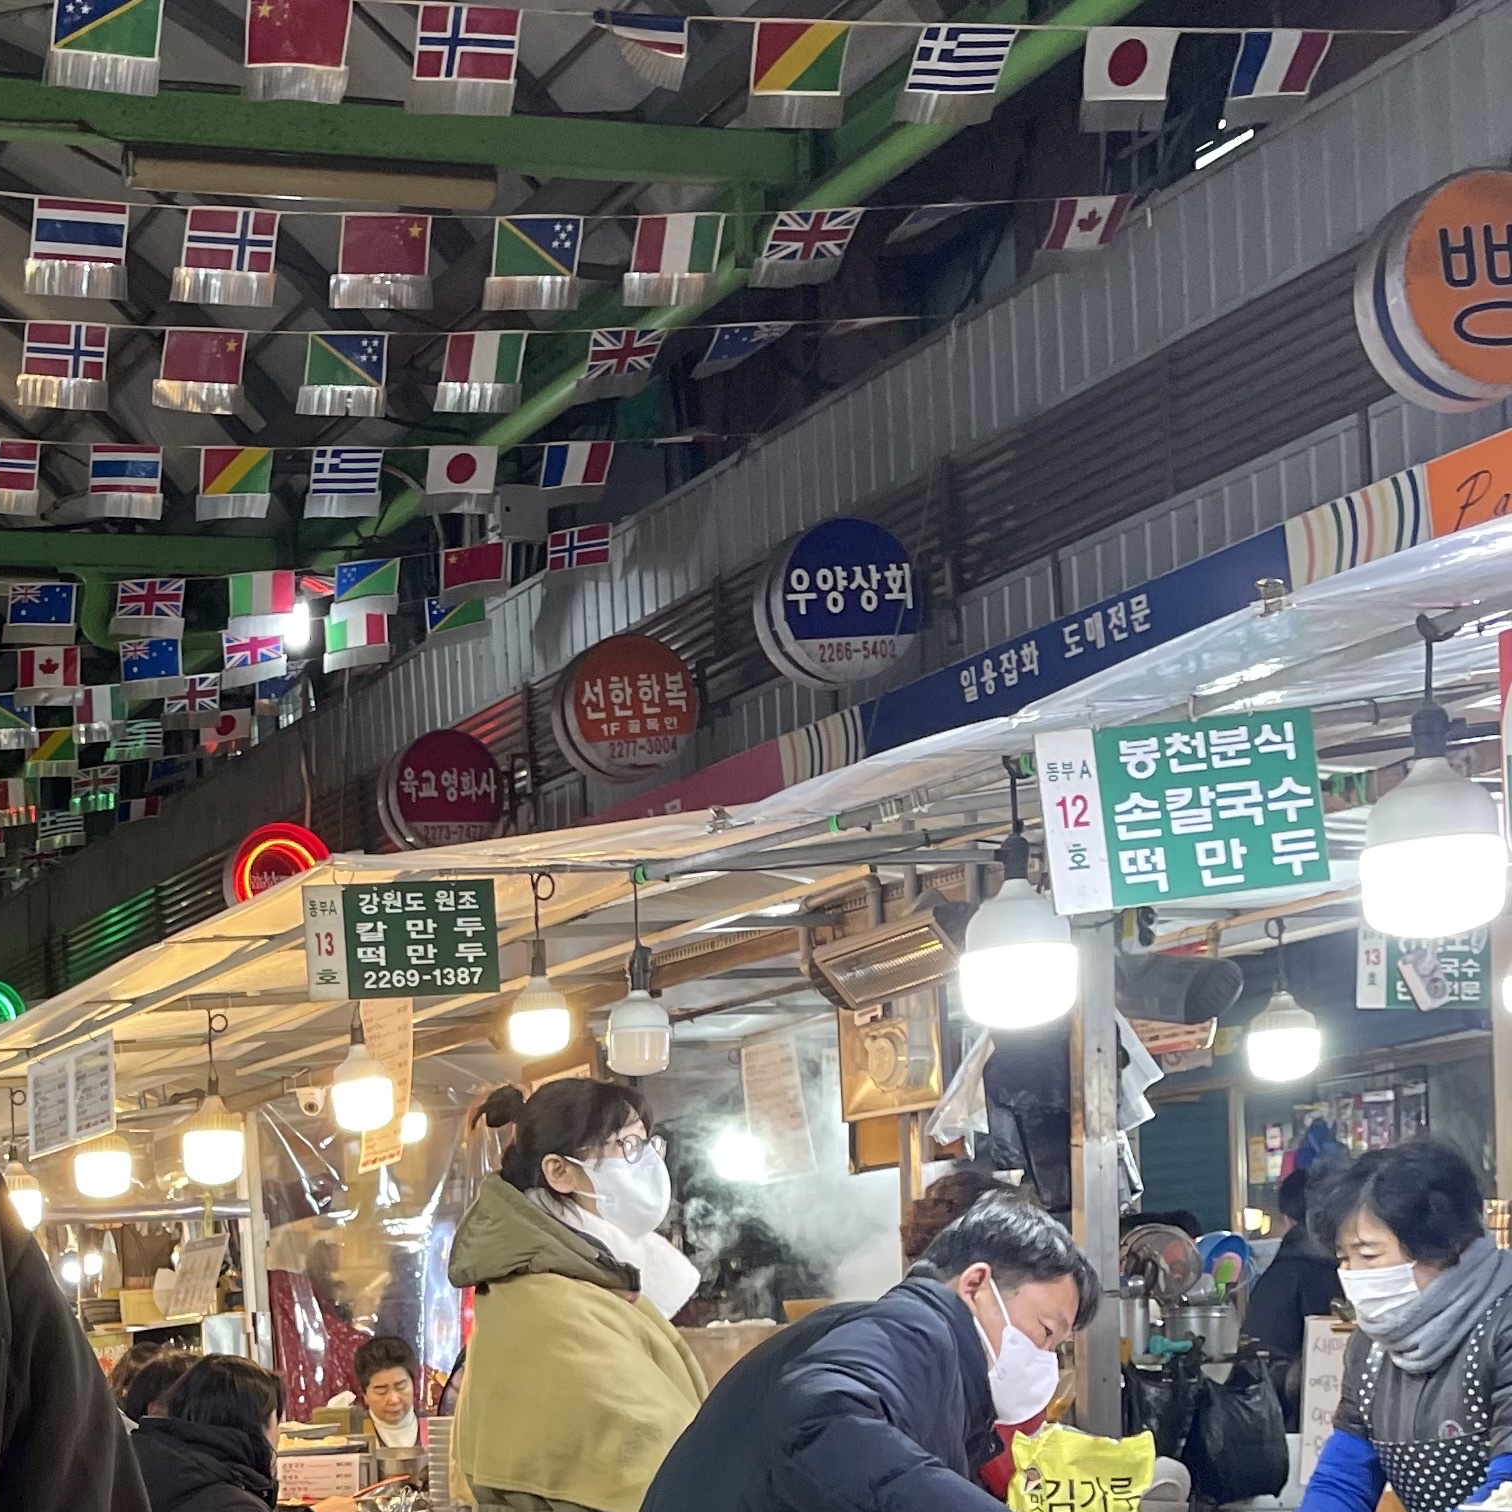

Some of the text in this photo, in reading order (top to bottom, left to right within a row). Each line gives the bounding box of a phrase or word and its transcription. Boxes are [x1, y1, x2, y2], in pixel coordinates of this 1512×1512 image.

[785, 562, 914, 615] 우양상회
[960, 594, 1152, 703] 일용잡화 도매전문
[582, 671, 688, 720] 선한한복
[600, 722, 621, 737] 1F
[1118, 721, 1296, 780] 봉천분식
[1056, 794, 1090, 829] 12
[1114, 776, 1314, 841] 손칼국수
[1068, 843, 1090, 871] 호
[358, 889, 480, 914] 강원도 원조
[315, 932, 334, 956] 13
[1364, 948, 1381, 965] 13
[315, 969, 340, 985] 호
[364, 967, 483, 989] 2269-1387
